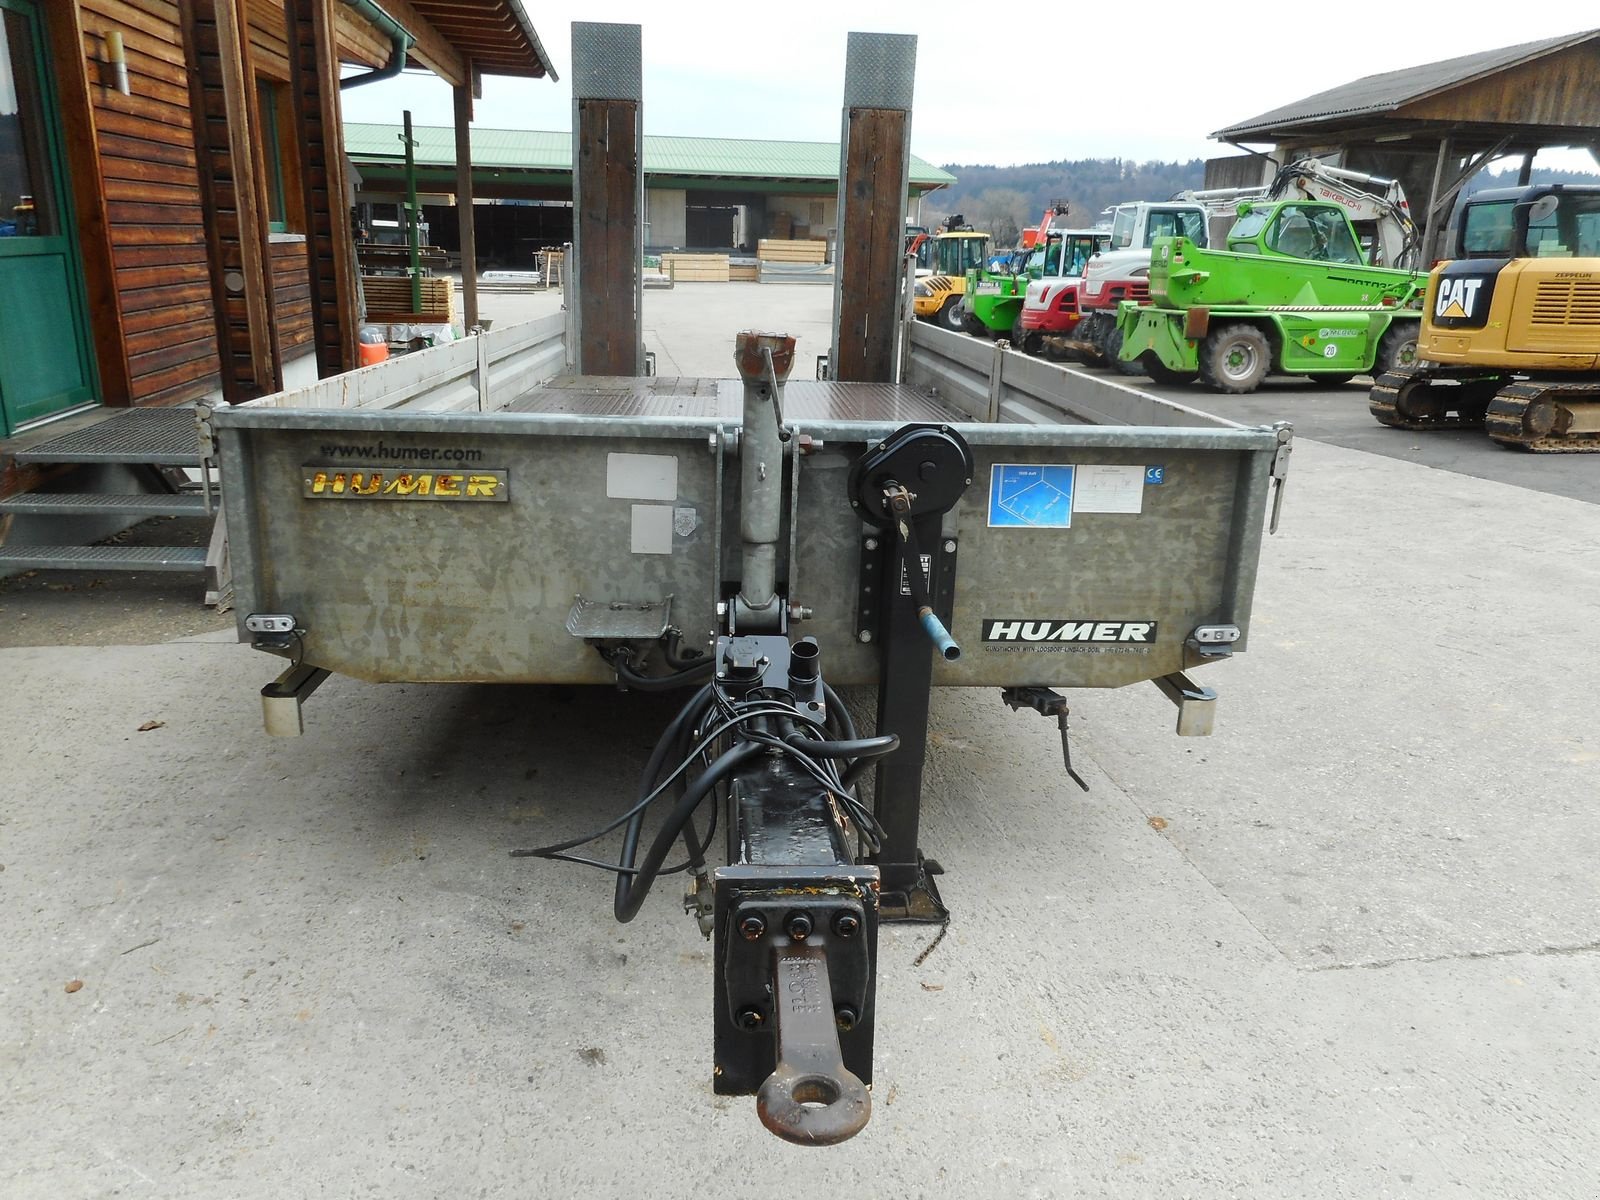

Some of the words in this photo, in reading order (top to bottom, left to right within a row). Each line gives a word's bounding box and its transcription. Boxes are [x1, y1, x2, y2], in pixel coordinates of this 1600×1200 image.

[1436, 278, 1483, 318] CAT
[1326, 346, 1335, 356] 20
[320, 441, 483, 462] www.humer.com
[312, 472, 498, 496] HUMER
[988, 621, 1151, 641] HUMER
